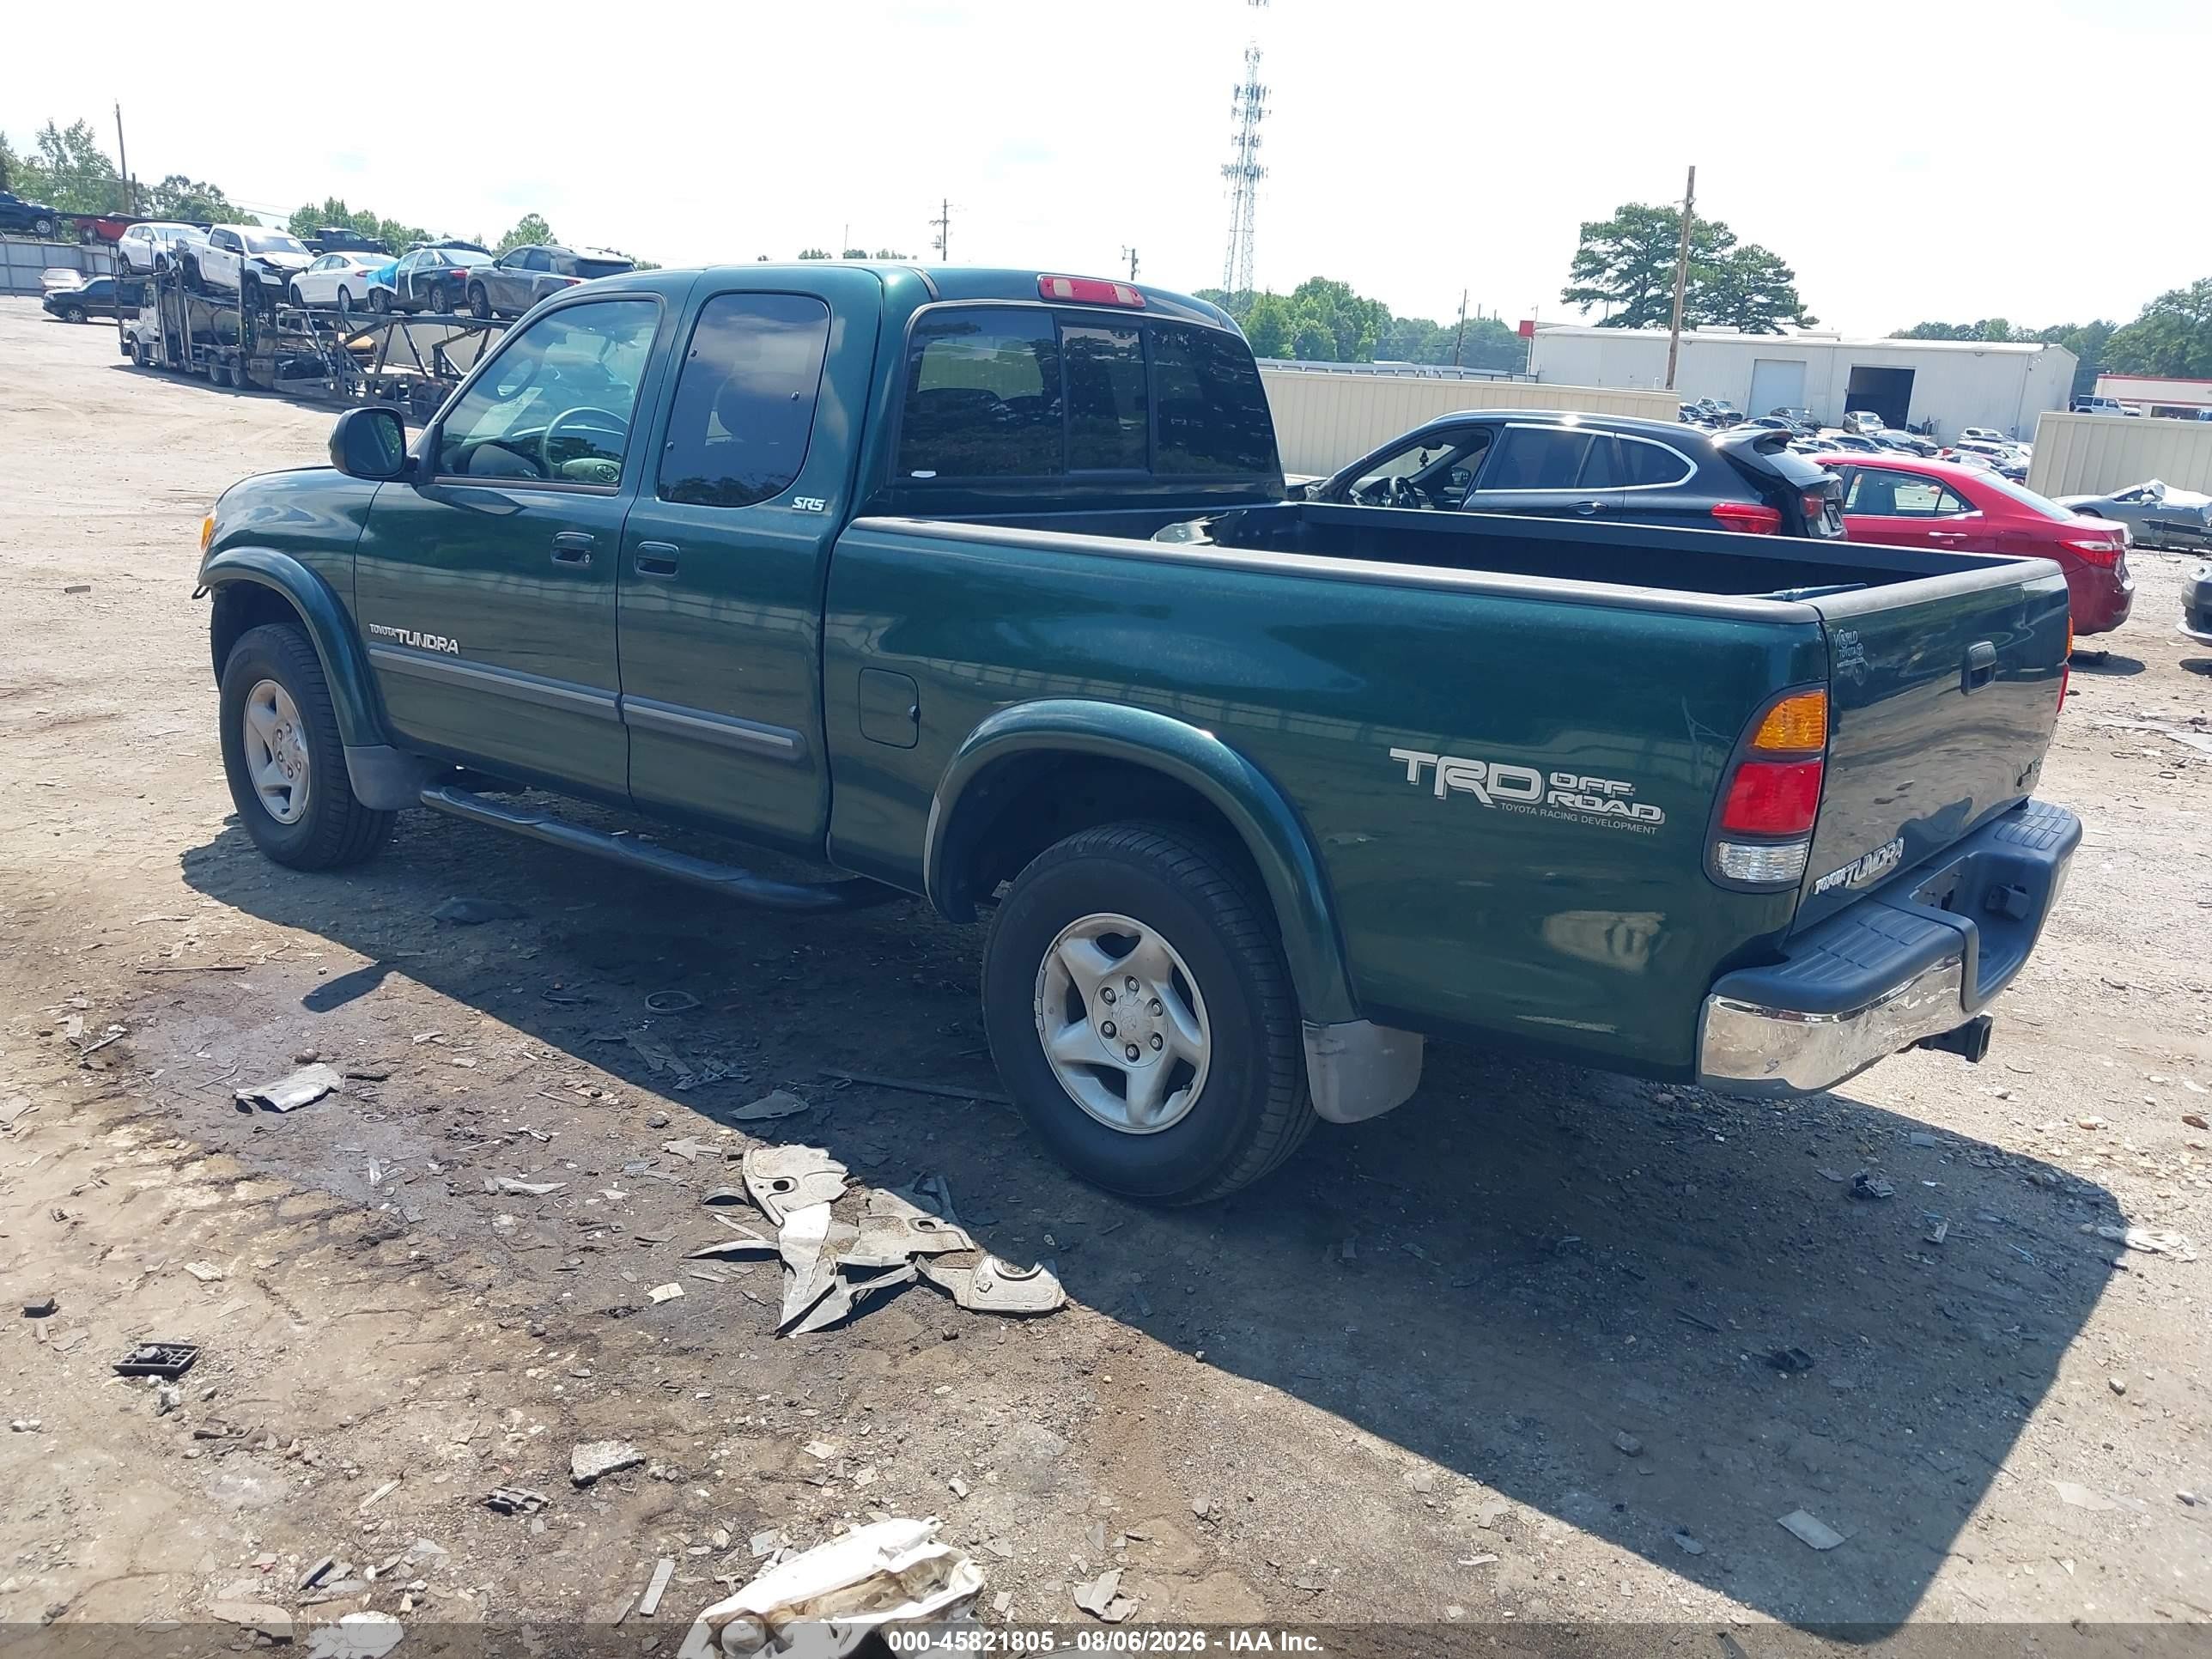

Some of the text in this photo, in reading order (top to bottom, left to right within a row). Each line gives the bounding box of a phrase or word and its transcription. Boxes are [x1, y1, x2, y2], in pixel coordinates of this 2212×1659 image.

[792, 496, 826, 512] SR5
[368, 623, 459, 654] TOYOTA TUNDRA
[1838, 647, 1856, 659] TOYOTA
[1389, 747, 1545, 809] TRD
[1548, 771, 1635, 797] OFF
[1500, 803, 1657, 836] TOYOTA RACING DEVELOPMENT
[1547, 790, 1666, 826] ROAD
[1814, 836, 1905, 895] TOYOTA TUNDRA
